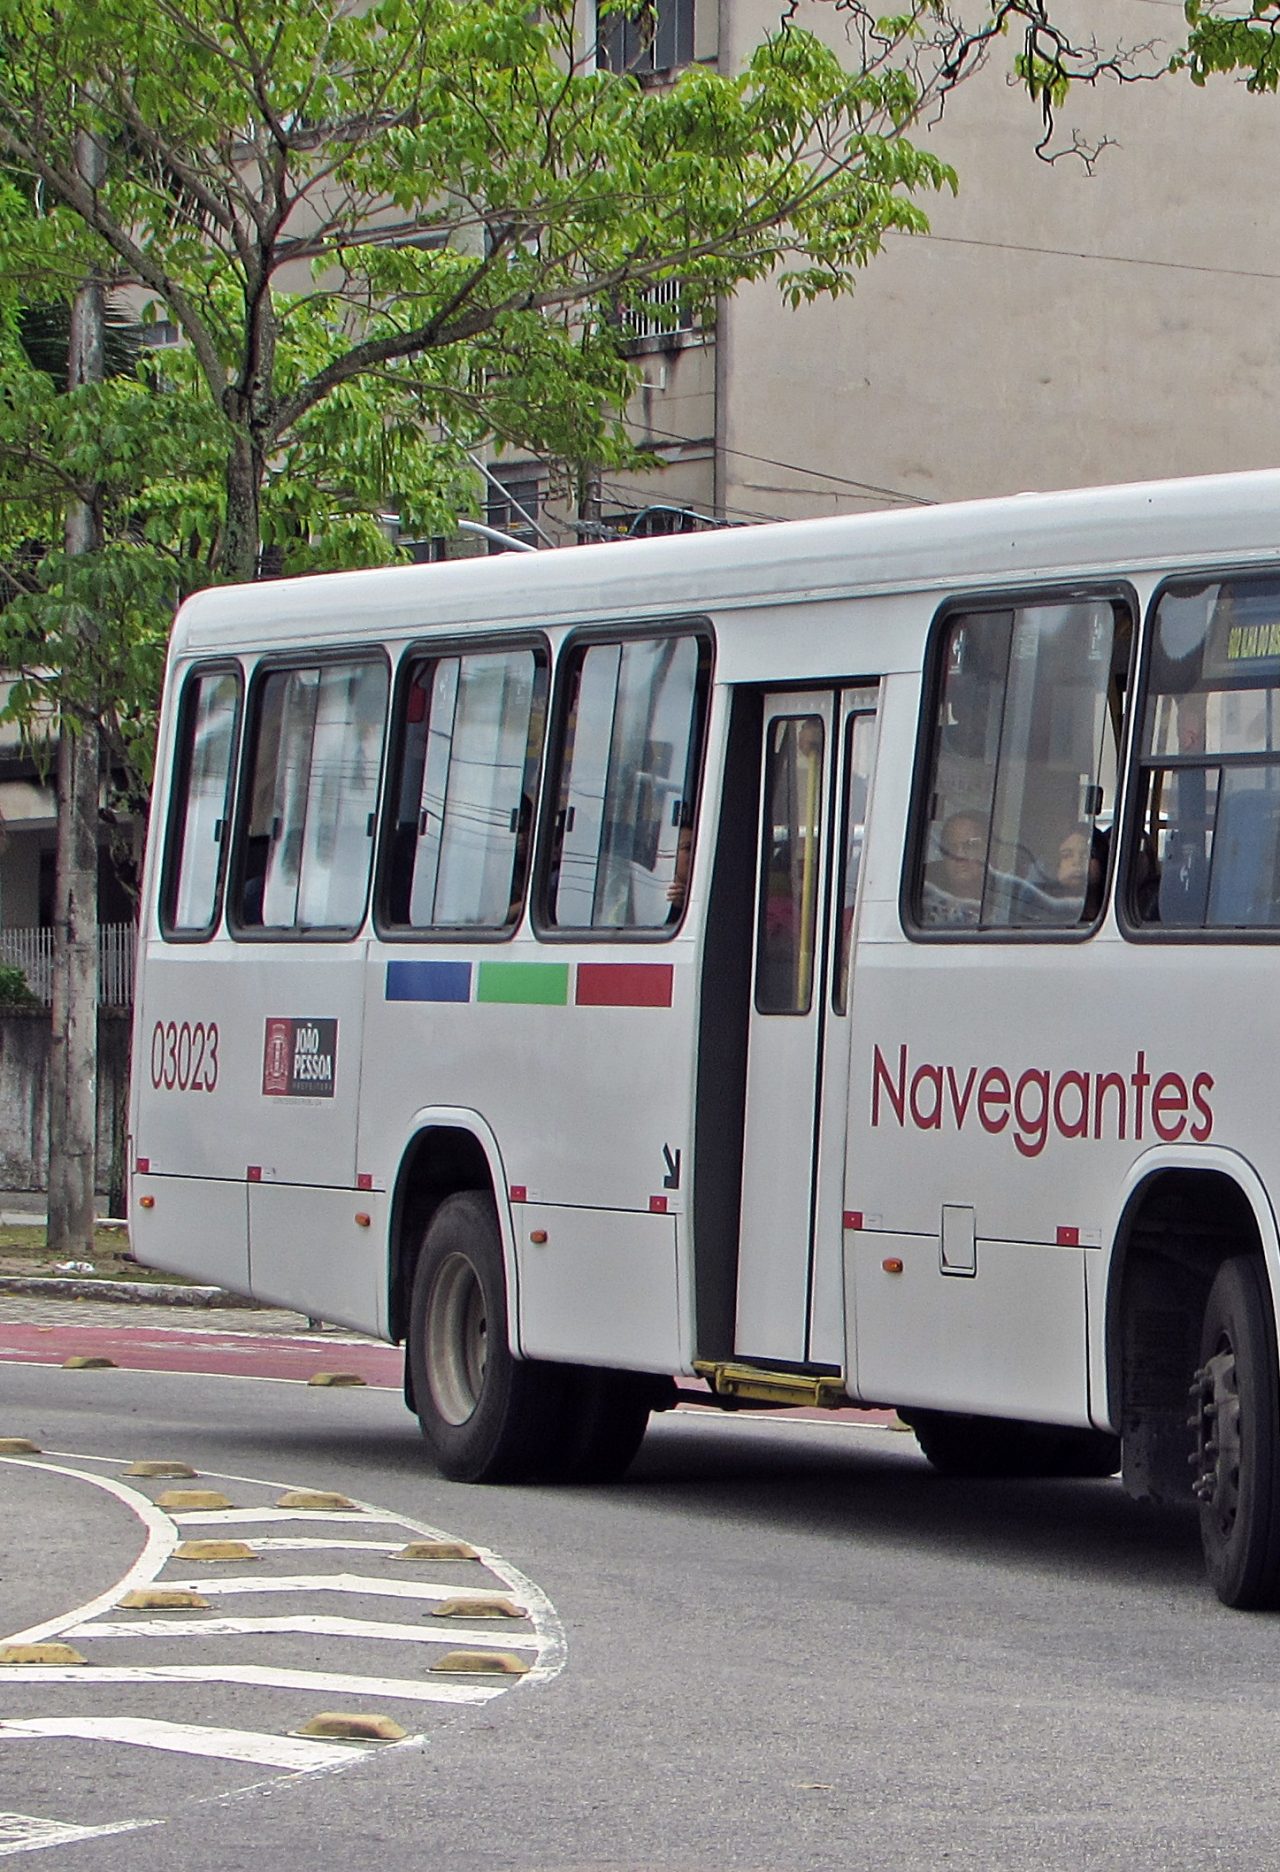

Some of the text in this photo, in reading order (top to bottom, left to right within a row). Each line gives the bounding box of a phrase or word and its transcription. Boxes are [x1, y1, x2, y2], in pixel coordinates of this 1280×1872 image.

[150, 1020, 219, 1093] 03023
[294, 1022, 320, 1054] JOÃO
[293, 1054, 332, 1080] PESSOA
[871, 1043, 1215, 1158] Navegantes
